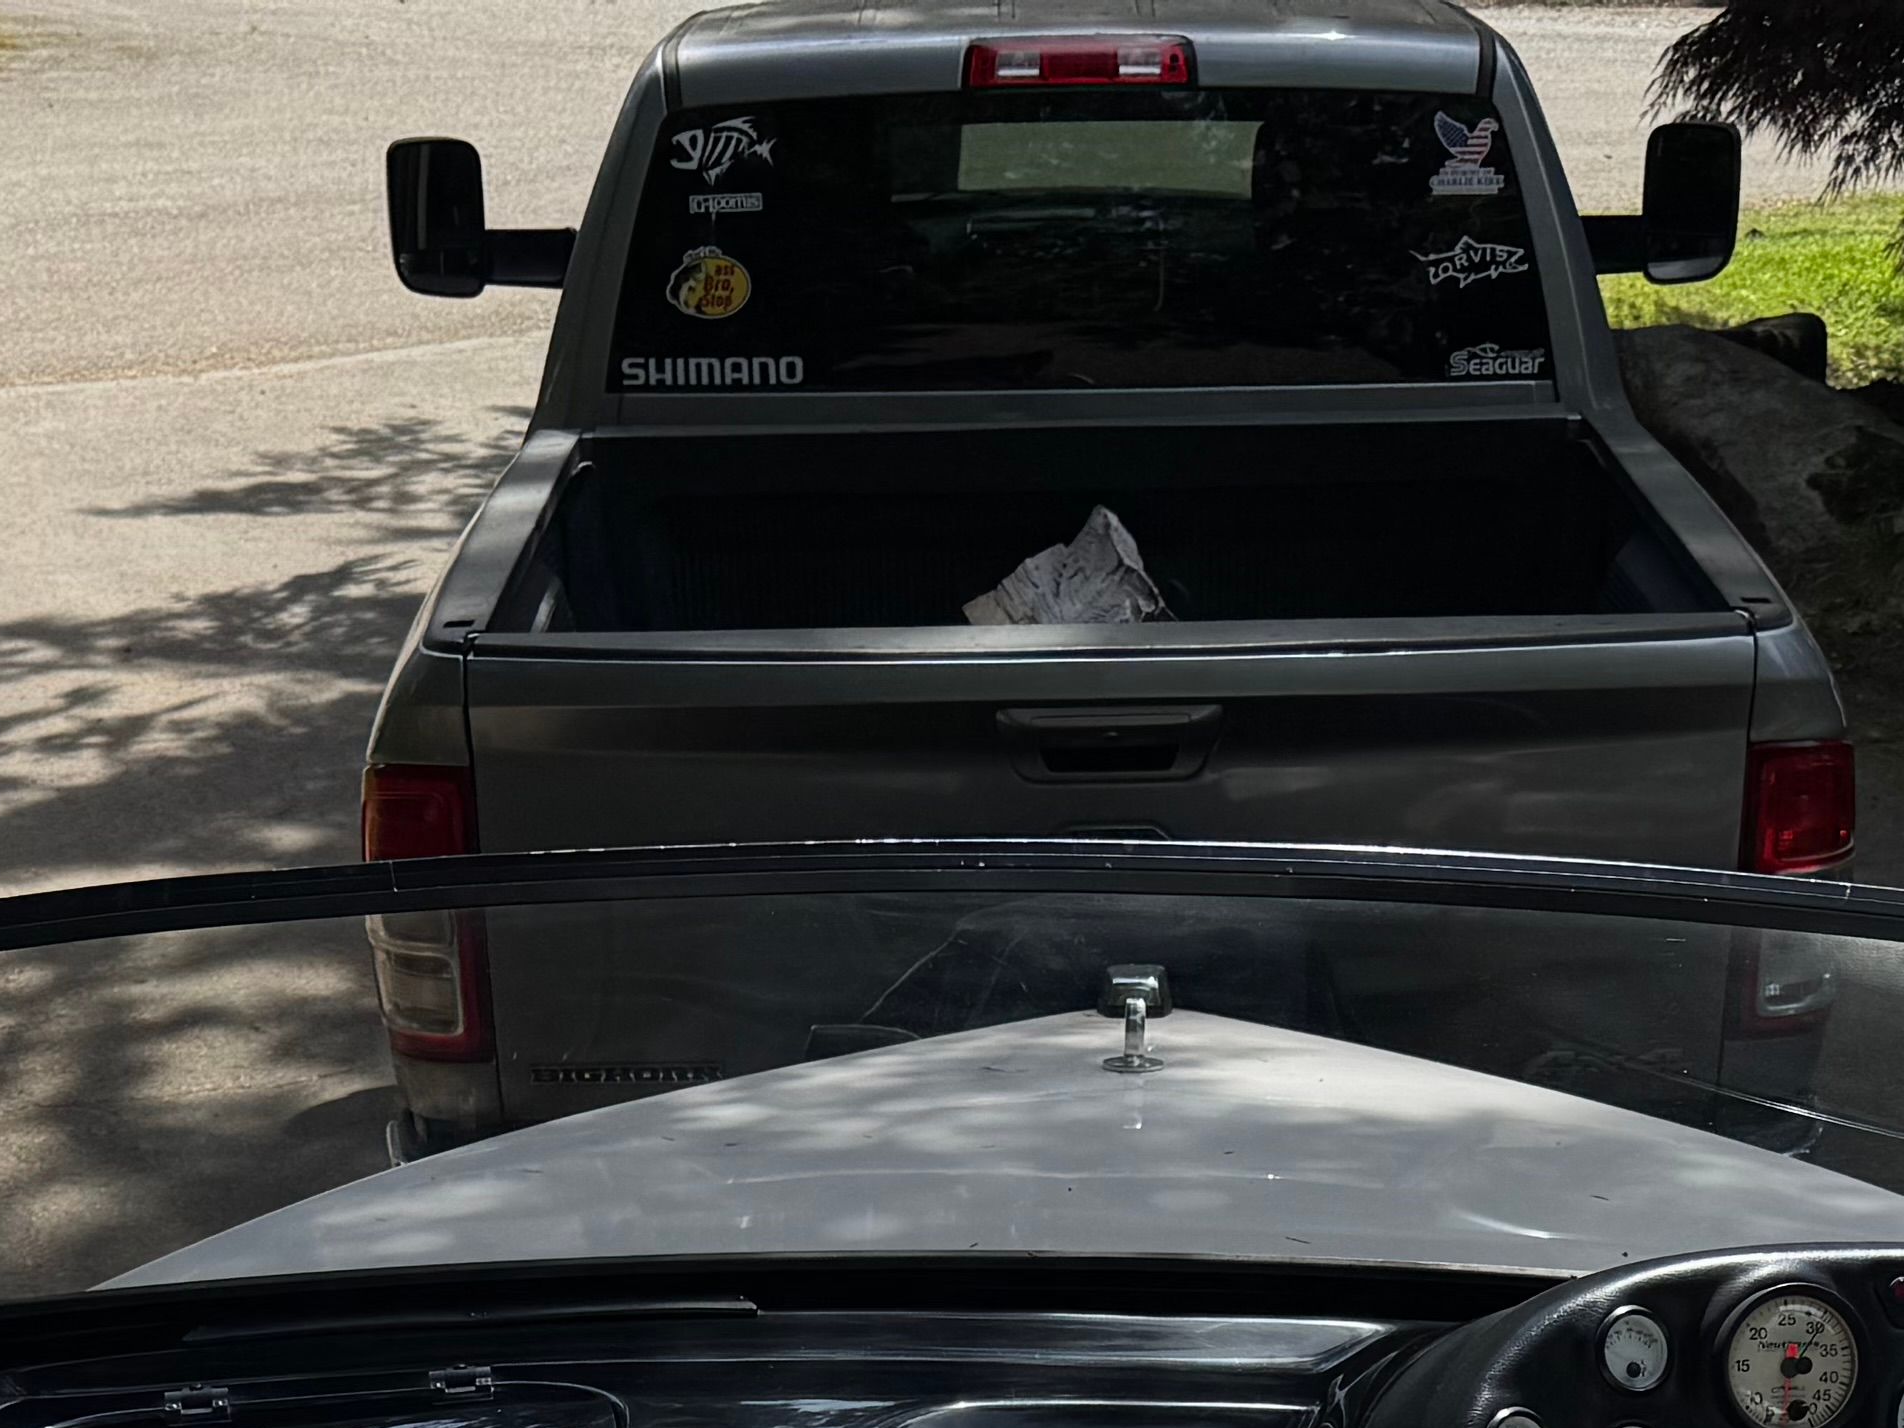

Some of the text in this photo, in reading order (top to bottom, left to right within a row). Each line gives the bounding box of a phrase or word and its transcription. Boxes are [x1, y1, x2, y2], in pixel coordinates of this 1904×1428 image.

[1439, 248, 1508, 278] ORVIS
[621, 355, 804, 386] SHIMANO
[1450, 351, 1545, 376] Seaguar
[531, 1064, 722, 1083] BIGHORN
[1778, 1313, 1796, 1326] 25
[1749, 1327, 1768, 1341] 20
[1806, 1321, 1825, 1335] 30
[1820, 1343, 1838, 1358] 35
[1736, 1359, 1750, 1373] 15
[1819, 1371, 1839, 1384] 40
[1813, 1389, 1831, 1402] 45
